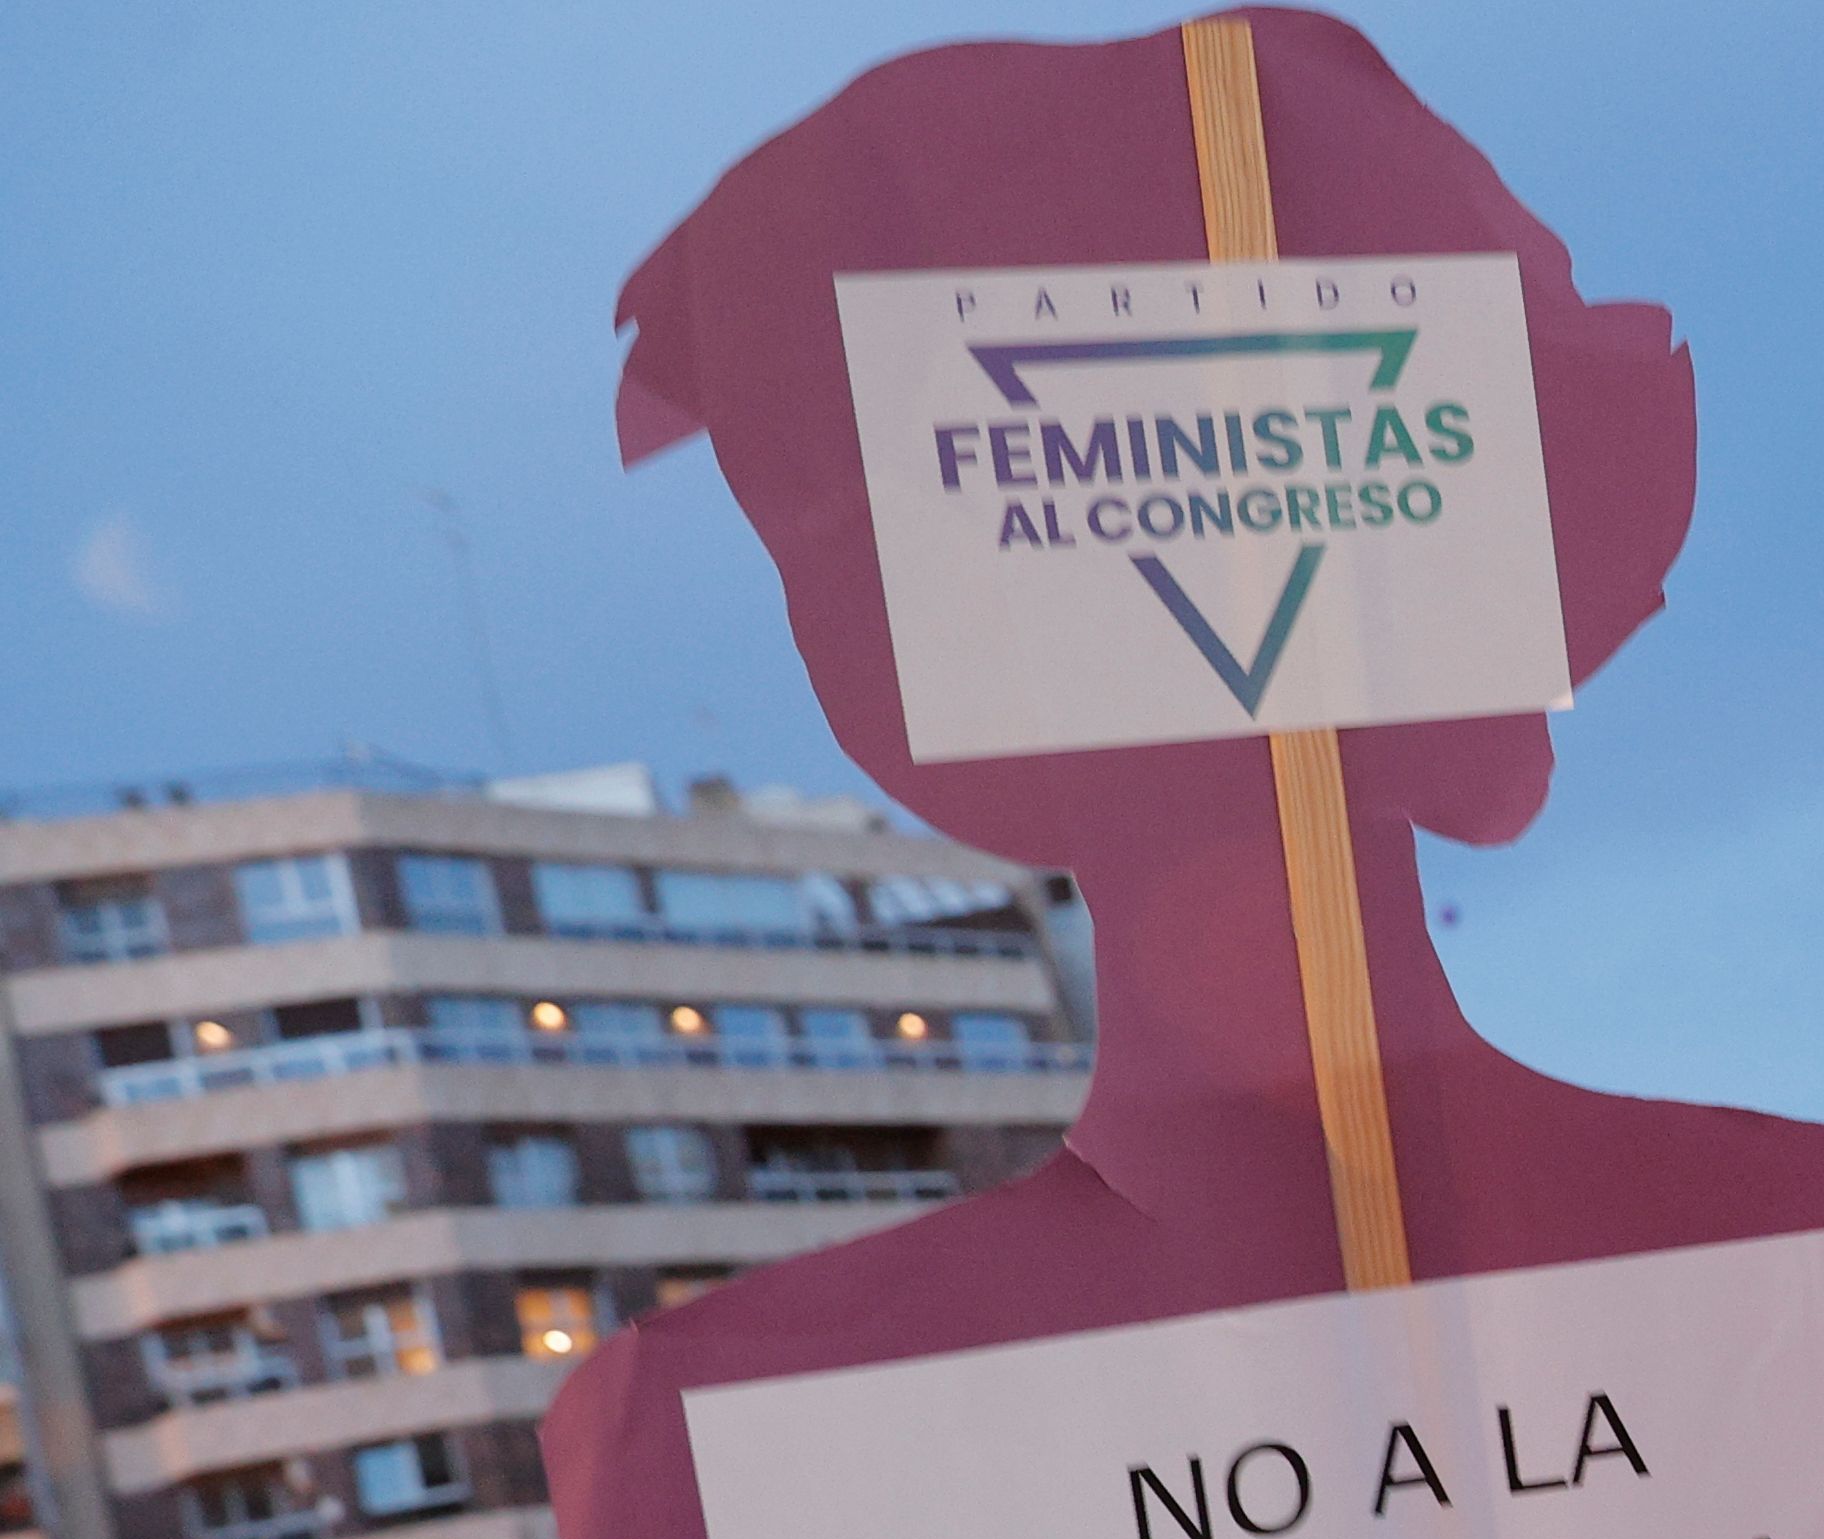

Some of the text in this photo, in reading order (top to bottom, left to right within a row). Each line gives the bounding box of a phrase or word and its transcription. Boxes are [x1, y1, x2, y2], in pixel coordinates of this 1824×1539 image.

[954, 276, 1420, 324] PARTIDO
[932, 402, 1476, 490] FEMINISTAS
[997, 479, 1444, 550] AL CONGRESO
[1370, 1419, 1455, 1519] A
[1494, 1390, 1652, 1496] LA
